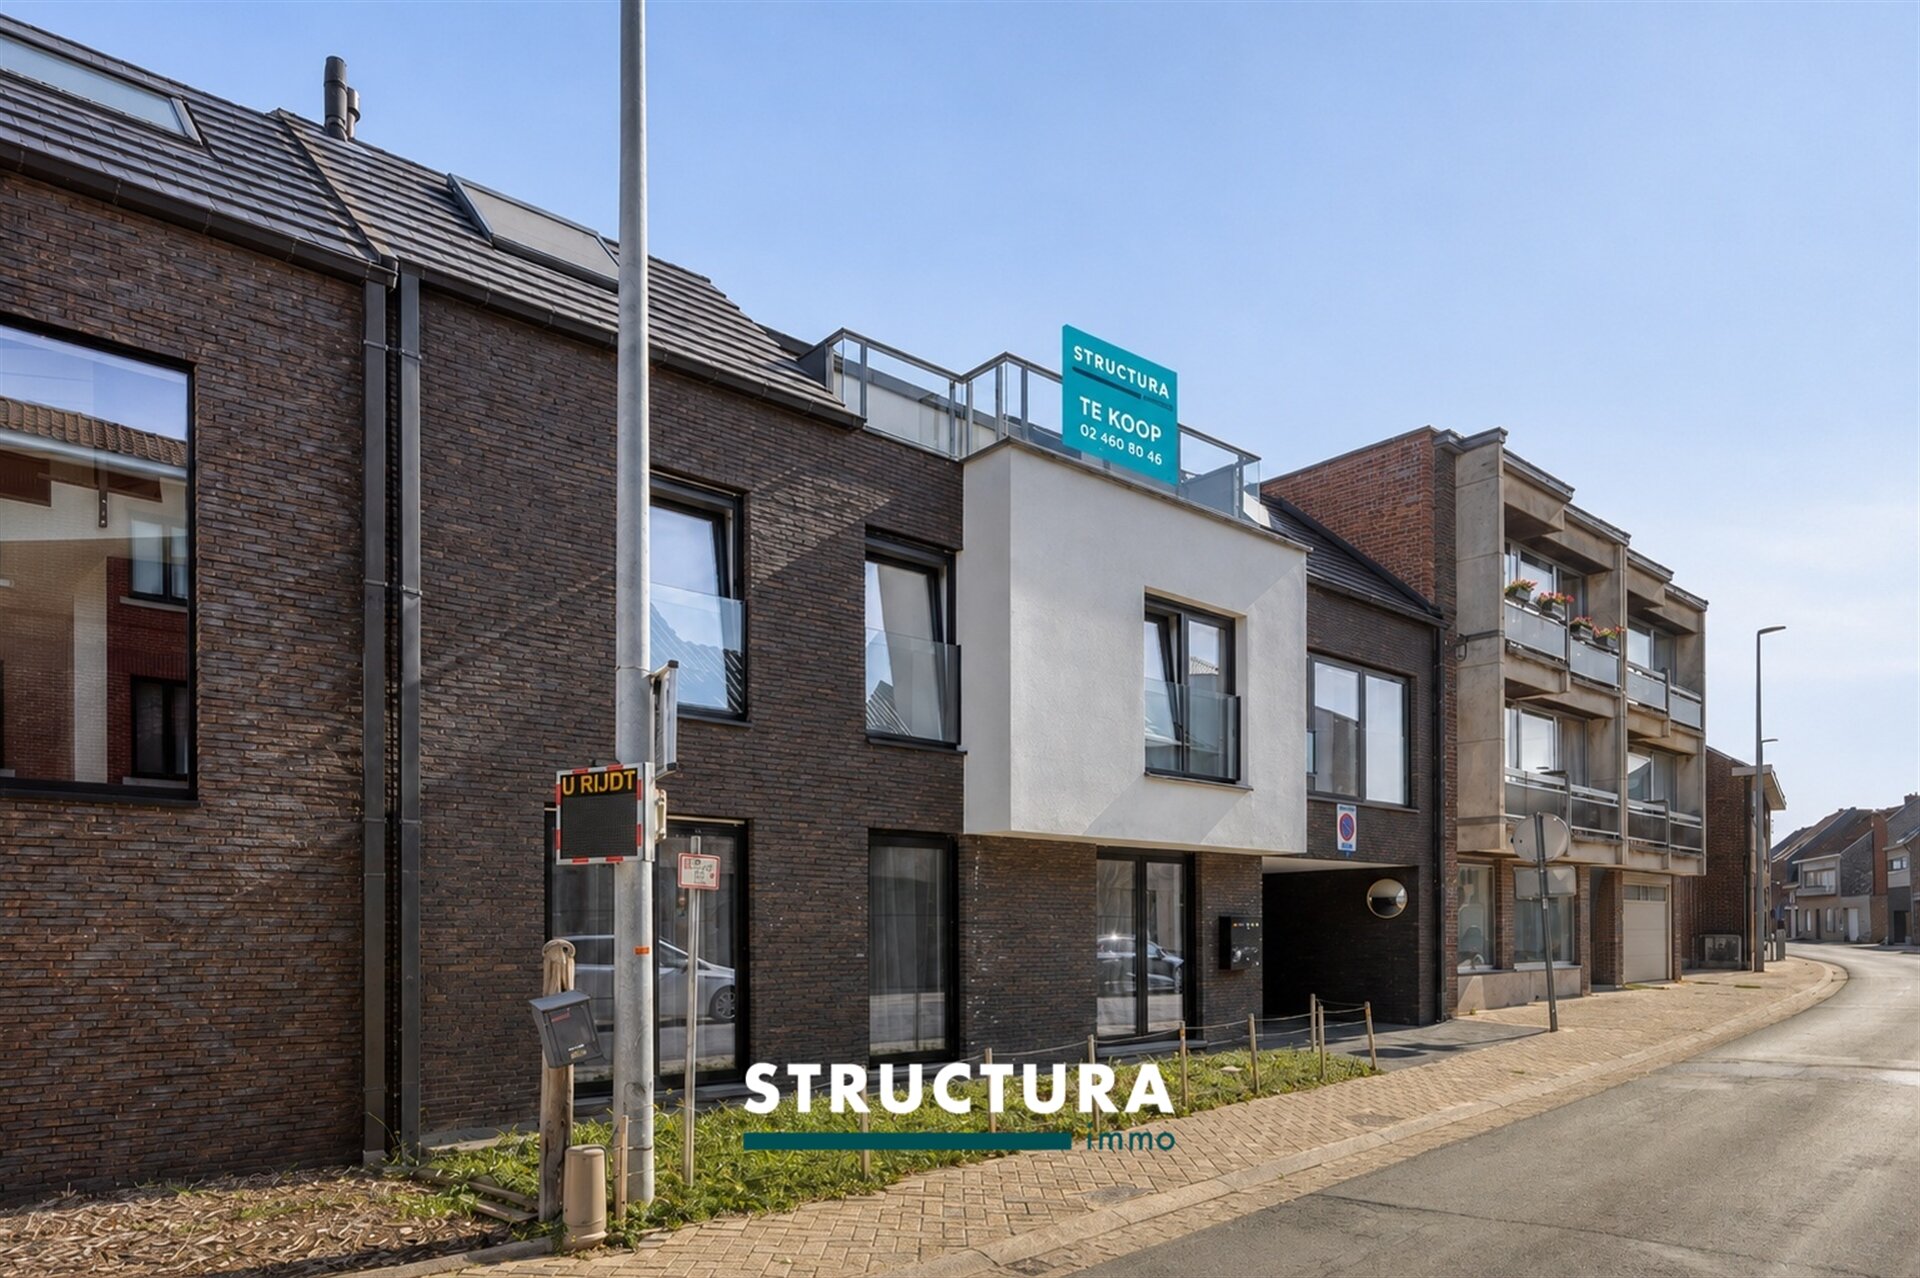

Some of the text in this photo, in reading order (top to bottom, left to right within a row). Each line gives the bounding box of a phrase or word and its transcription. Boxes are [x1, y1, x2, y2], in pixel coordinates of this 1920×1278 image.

[1073, 345, 1170, 399] STRUCTURA
[1079, 396, 1162, 442] TE KOOP
[1080, 424, 1162, 465] 02 460 80 46
[562, 770, 636, 796] U RIJDT
